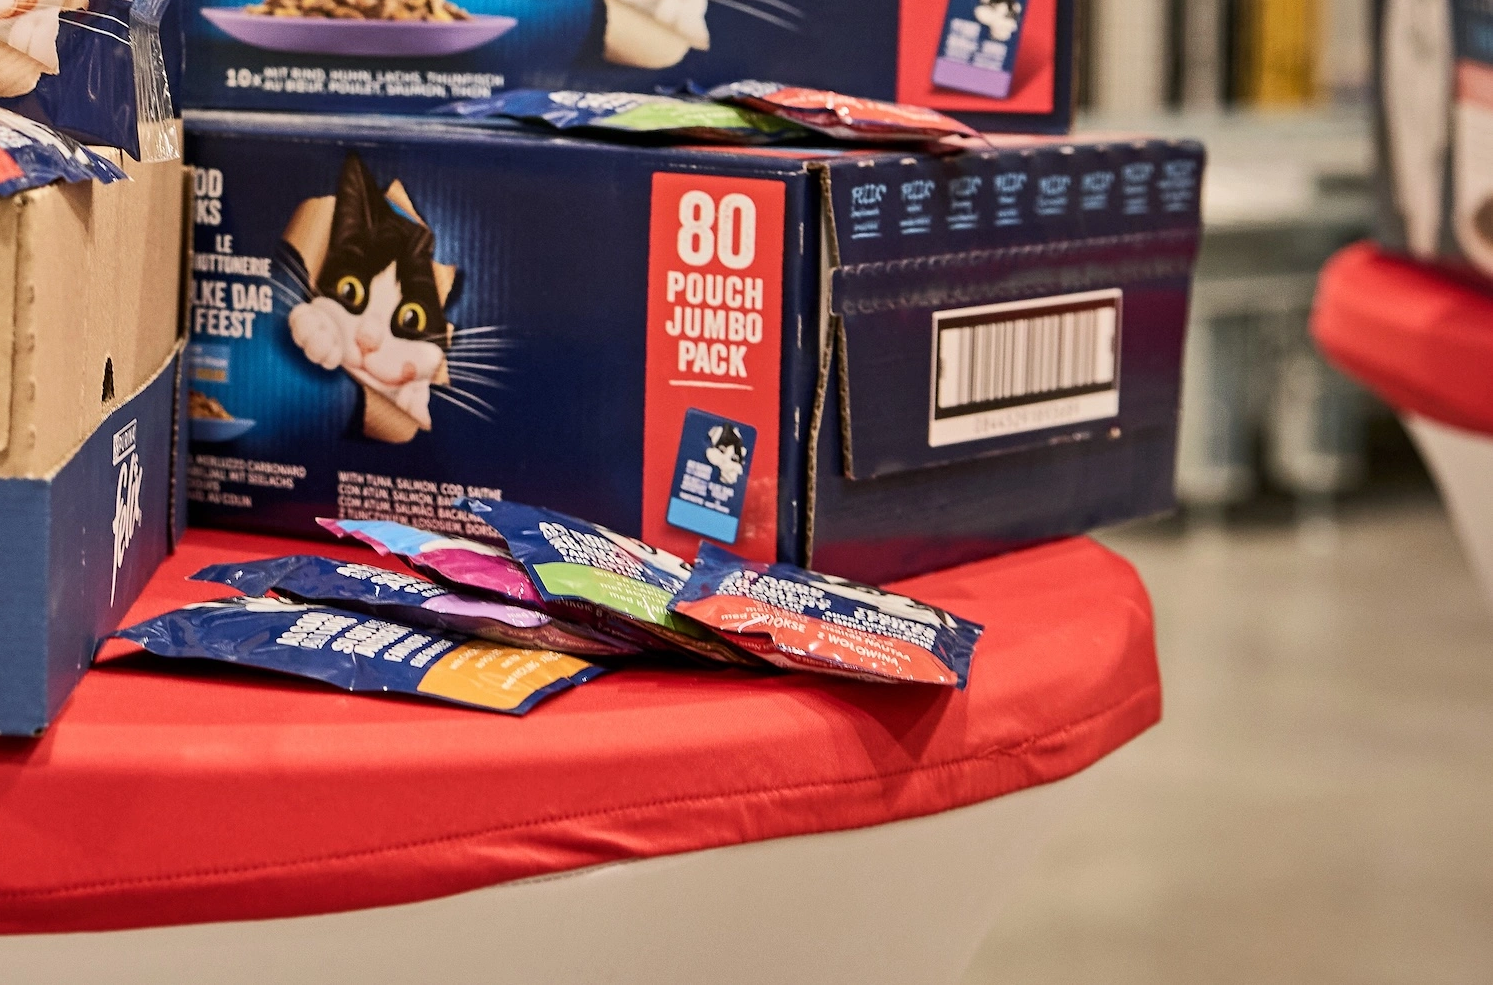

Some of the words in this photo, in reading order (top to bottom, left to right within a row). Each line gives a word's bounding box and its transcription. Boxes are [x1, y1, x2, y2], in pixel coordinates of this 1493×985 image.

[226, 68, 262, 88] 10x
[215, 234, 233, 254] LE
[677, 190, 757, 270] 80
[231, 283, 273, 313] DAG
[666, 270, 763, 310] POUCH
[194, 308, 256, 339] FEEST
[665, 306, 763, 344] JUMBO
[678, 339, 747, 378] PACK
